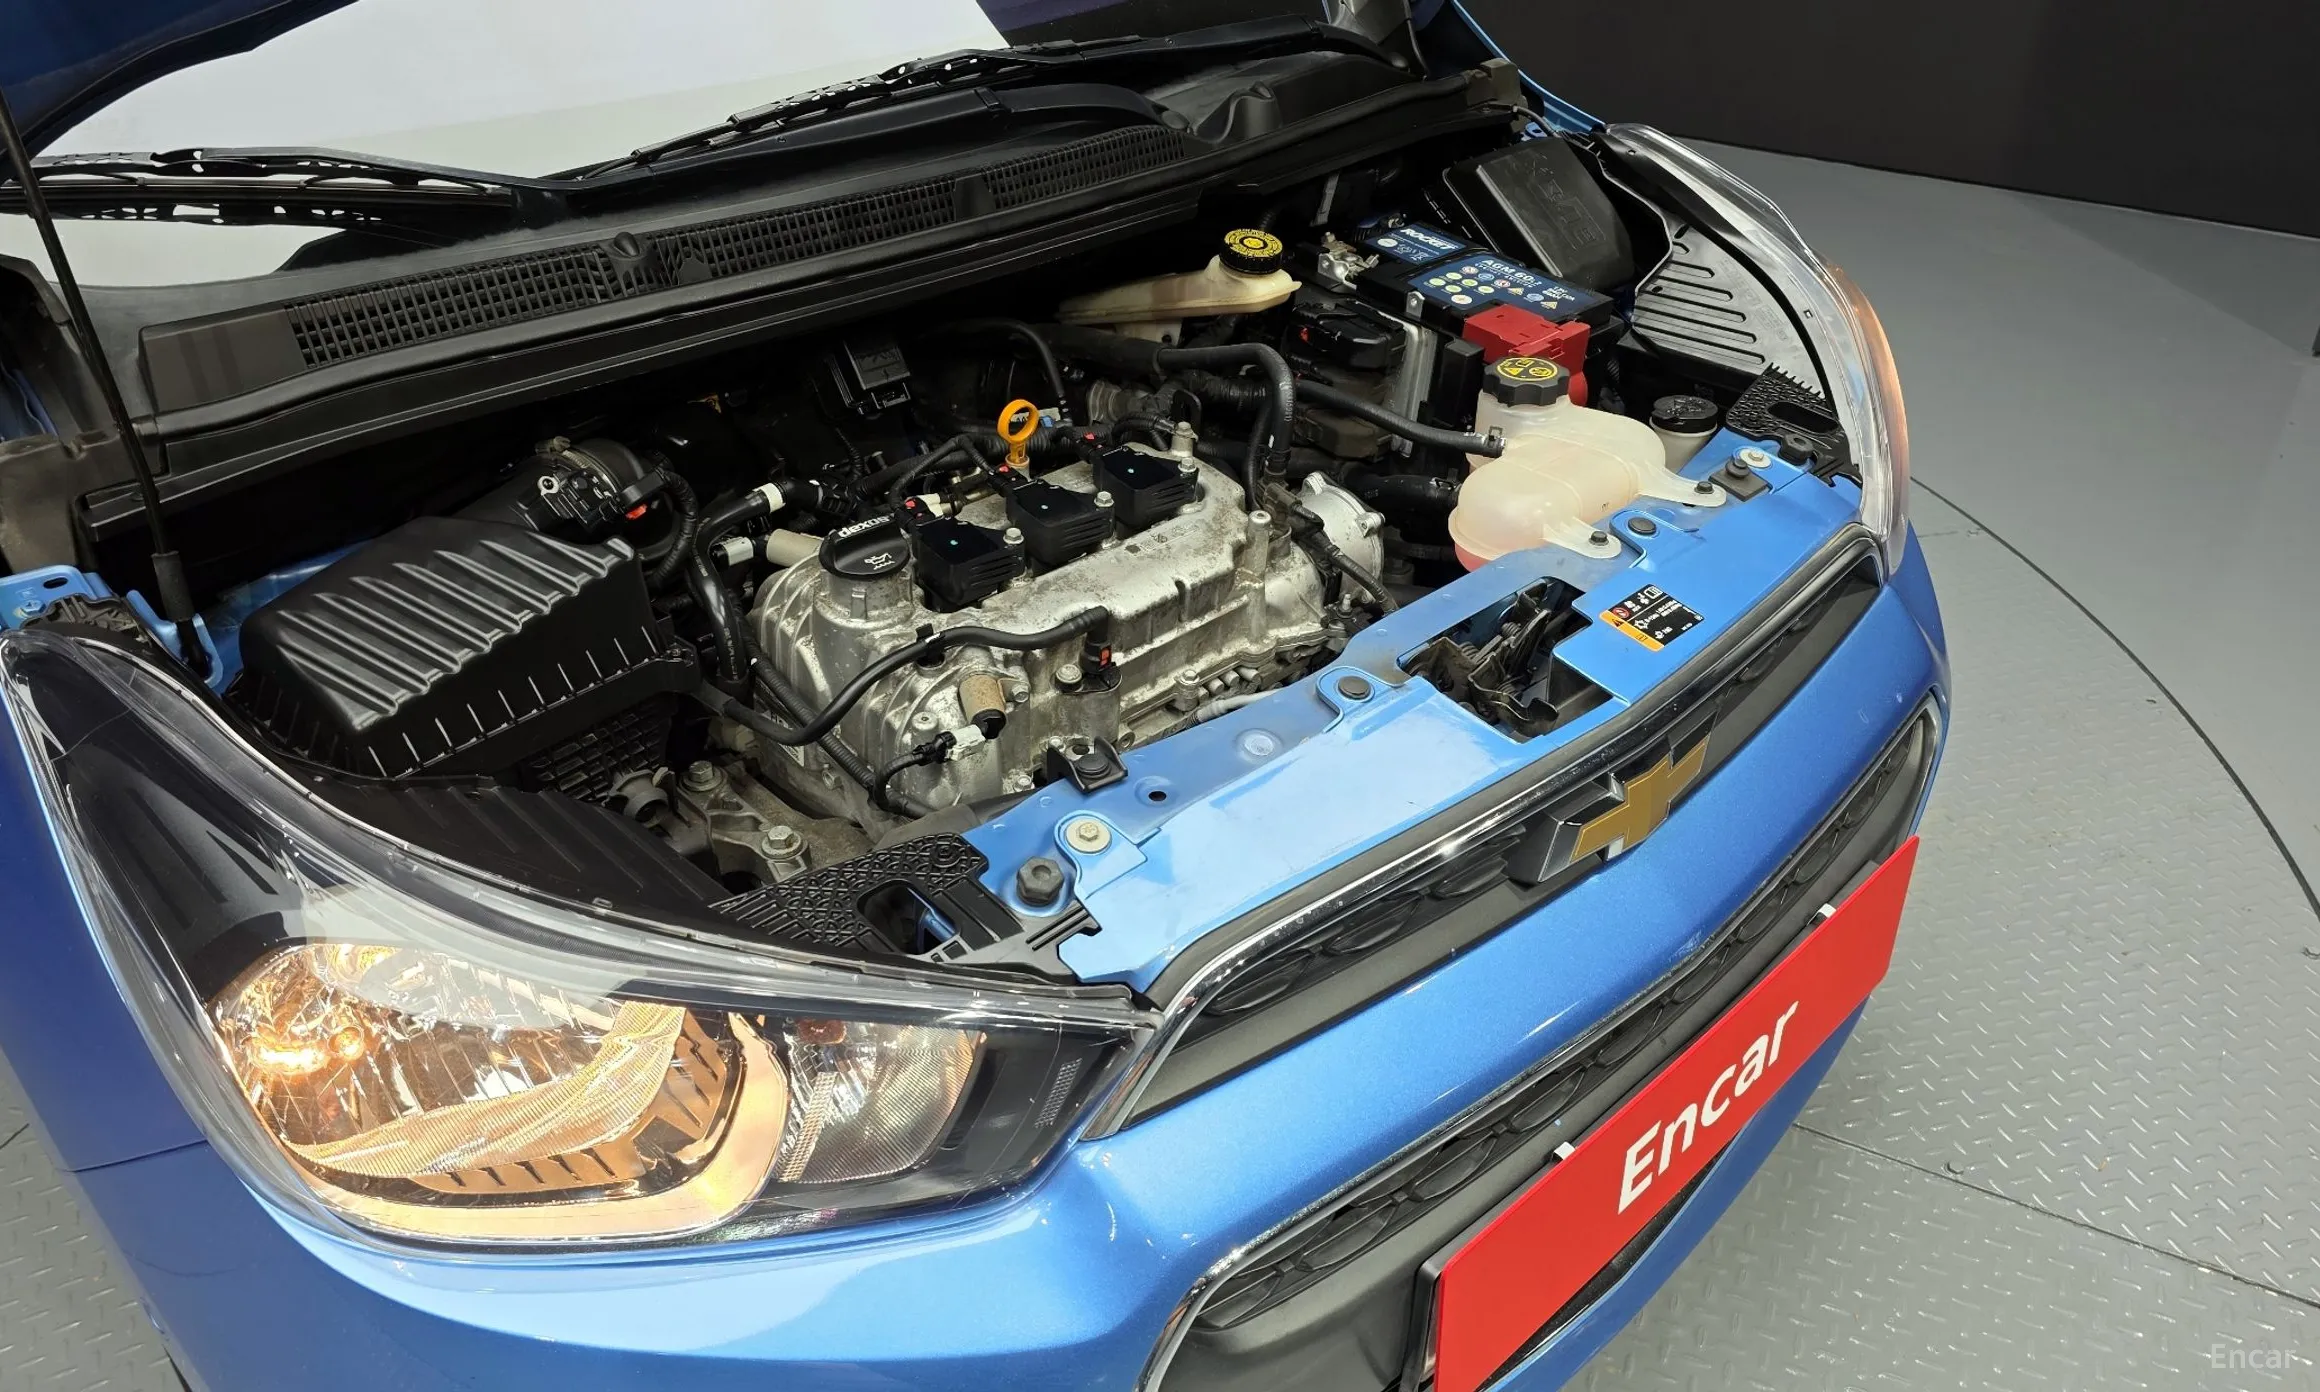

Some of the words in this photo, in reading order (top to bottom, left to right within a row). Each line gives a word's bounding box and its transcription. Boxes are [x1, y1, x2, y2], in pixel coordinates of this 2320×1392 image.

[1400, 228, 1457, 250] ROCKET
[1481, 259, 1516, 274] AGM
[838, 515, 890, 537] dexos
[1618, 1000, 1800, 1215] Encar
